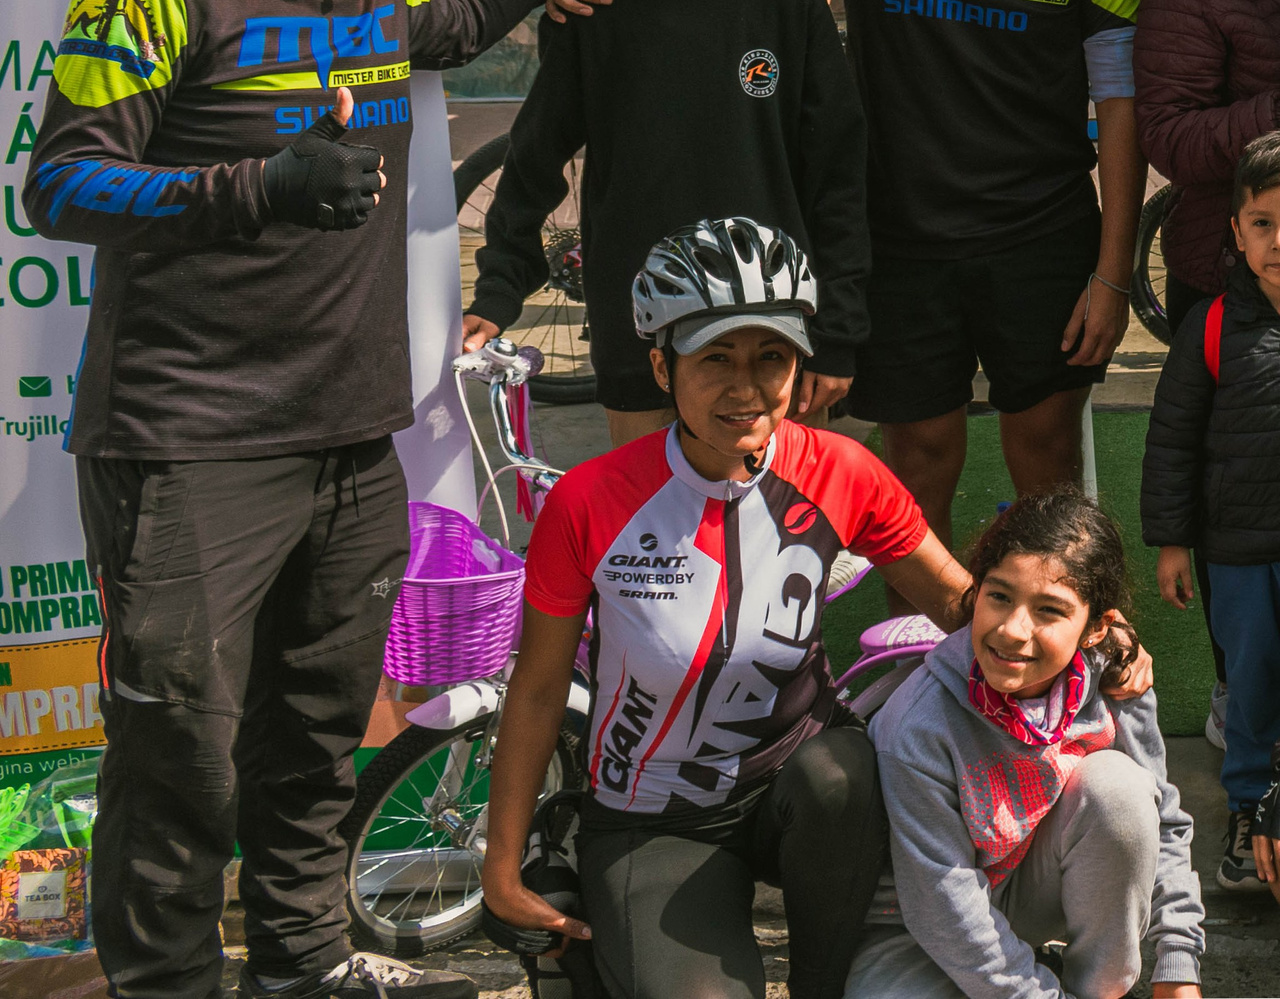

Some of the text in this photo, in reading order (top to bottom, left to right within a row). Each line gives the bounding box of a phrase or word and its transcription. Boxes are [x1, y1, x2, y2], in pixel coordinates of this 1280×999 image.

[334, 68, 397, 86] MISTER BIKE
[274, 96, 410, 135] SHANO
[0, 255, 92, 309] OL
[10, 558, 97, 599] PRIM
[25, 893, 62, 903] TEA BOX
